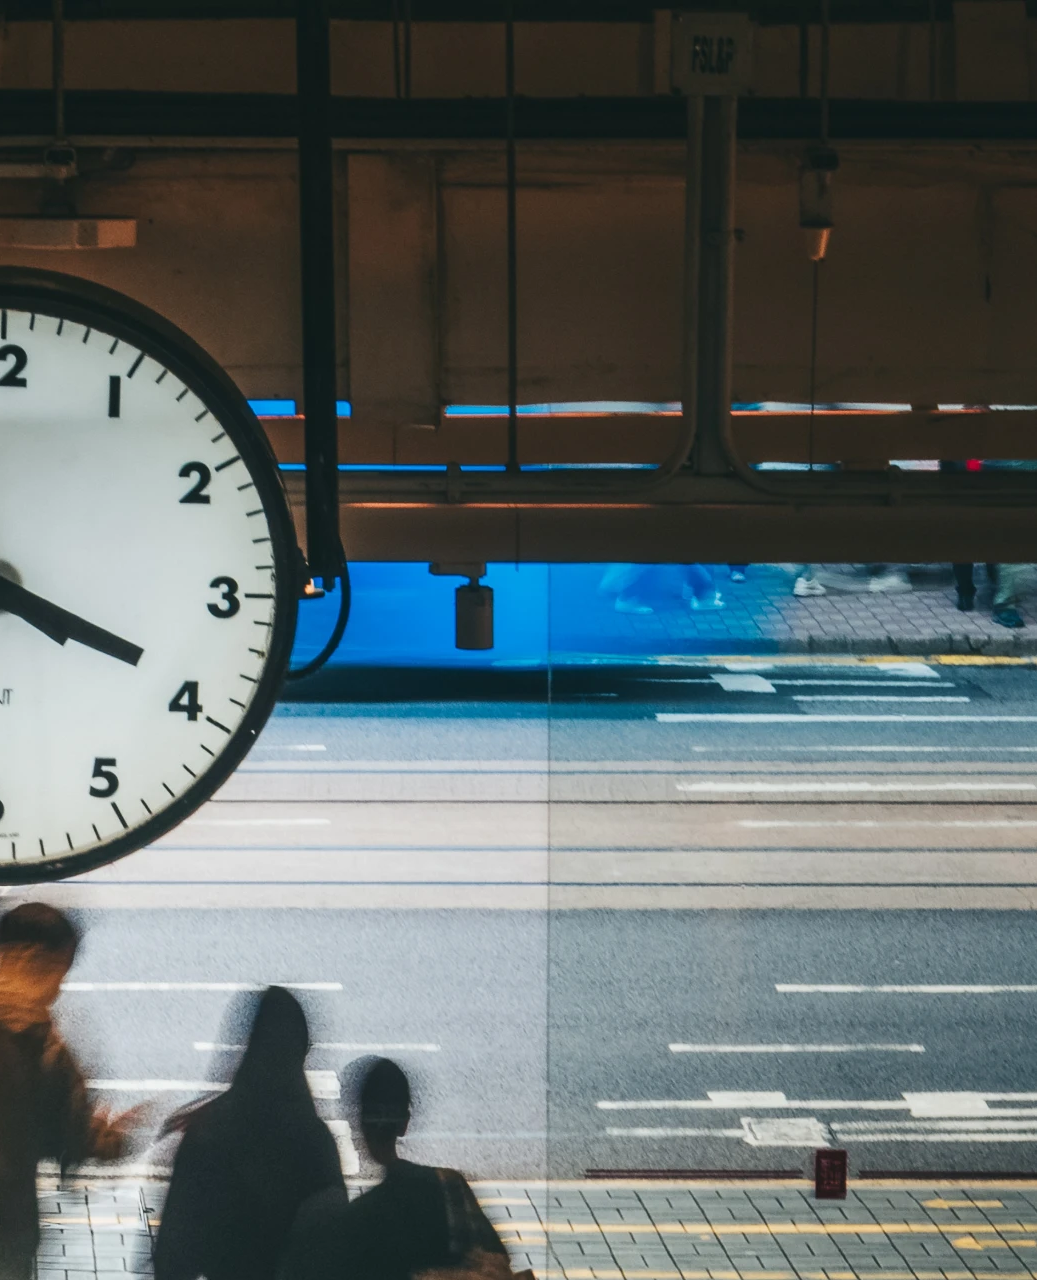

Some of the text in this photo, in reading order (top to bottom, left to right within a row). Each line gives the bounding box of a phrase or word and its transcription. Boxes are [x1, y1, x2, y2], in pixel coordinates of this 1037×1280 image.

[108, 375, 121, 419] 1
[178, 461, 211, 504] 2
[207, 576, 240, 619] 3
[169, 681, 203, 721] 4
[89, 758, 119, 798] 5
